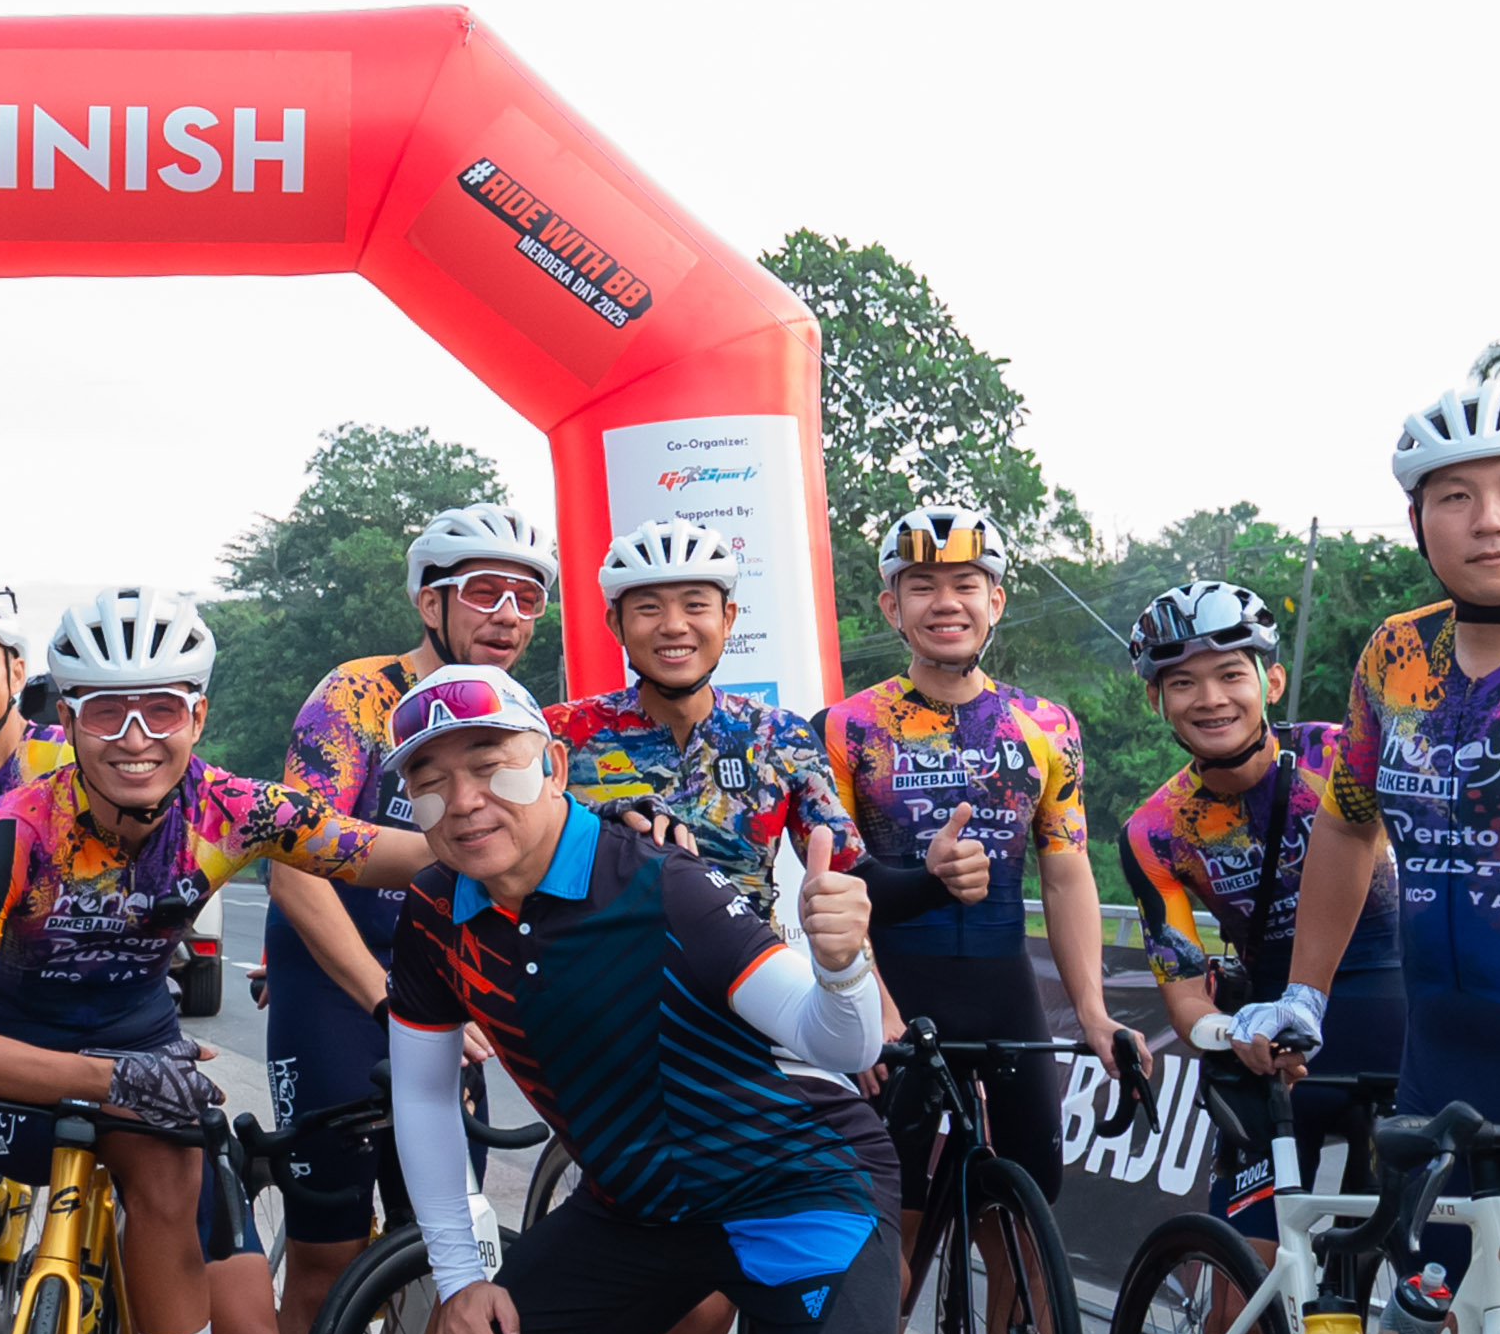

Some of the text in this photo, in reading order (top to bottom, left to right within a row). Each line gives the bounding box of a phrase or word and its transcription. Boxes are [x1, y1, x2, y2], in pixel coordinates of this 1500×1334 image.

[463, 161, 649, 307] #RIDE WITH BB
[517, 235, 629, 327] MERDEKA DAY 2025
[667, 438, 749, 451] Co-Organizer:
[675, 506, 754, 522] Supported By:
[894, 771, 967, 789] BIKEBAJU
[1377, 769, 1458, 798] BIKEBAJU
[1235, 1158, 1270, 1191] T2002
